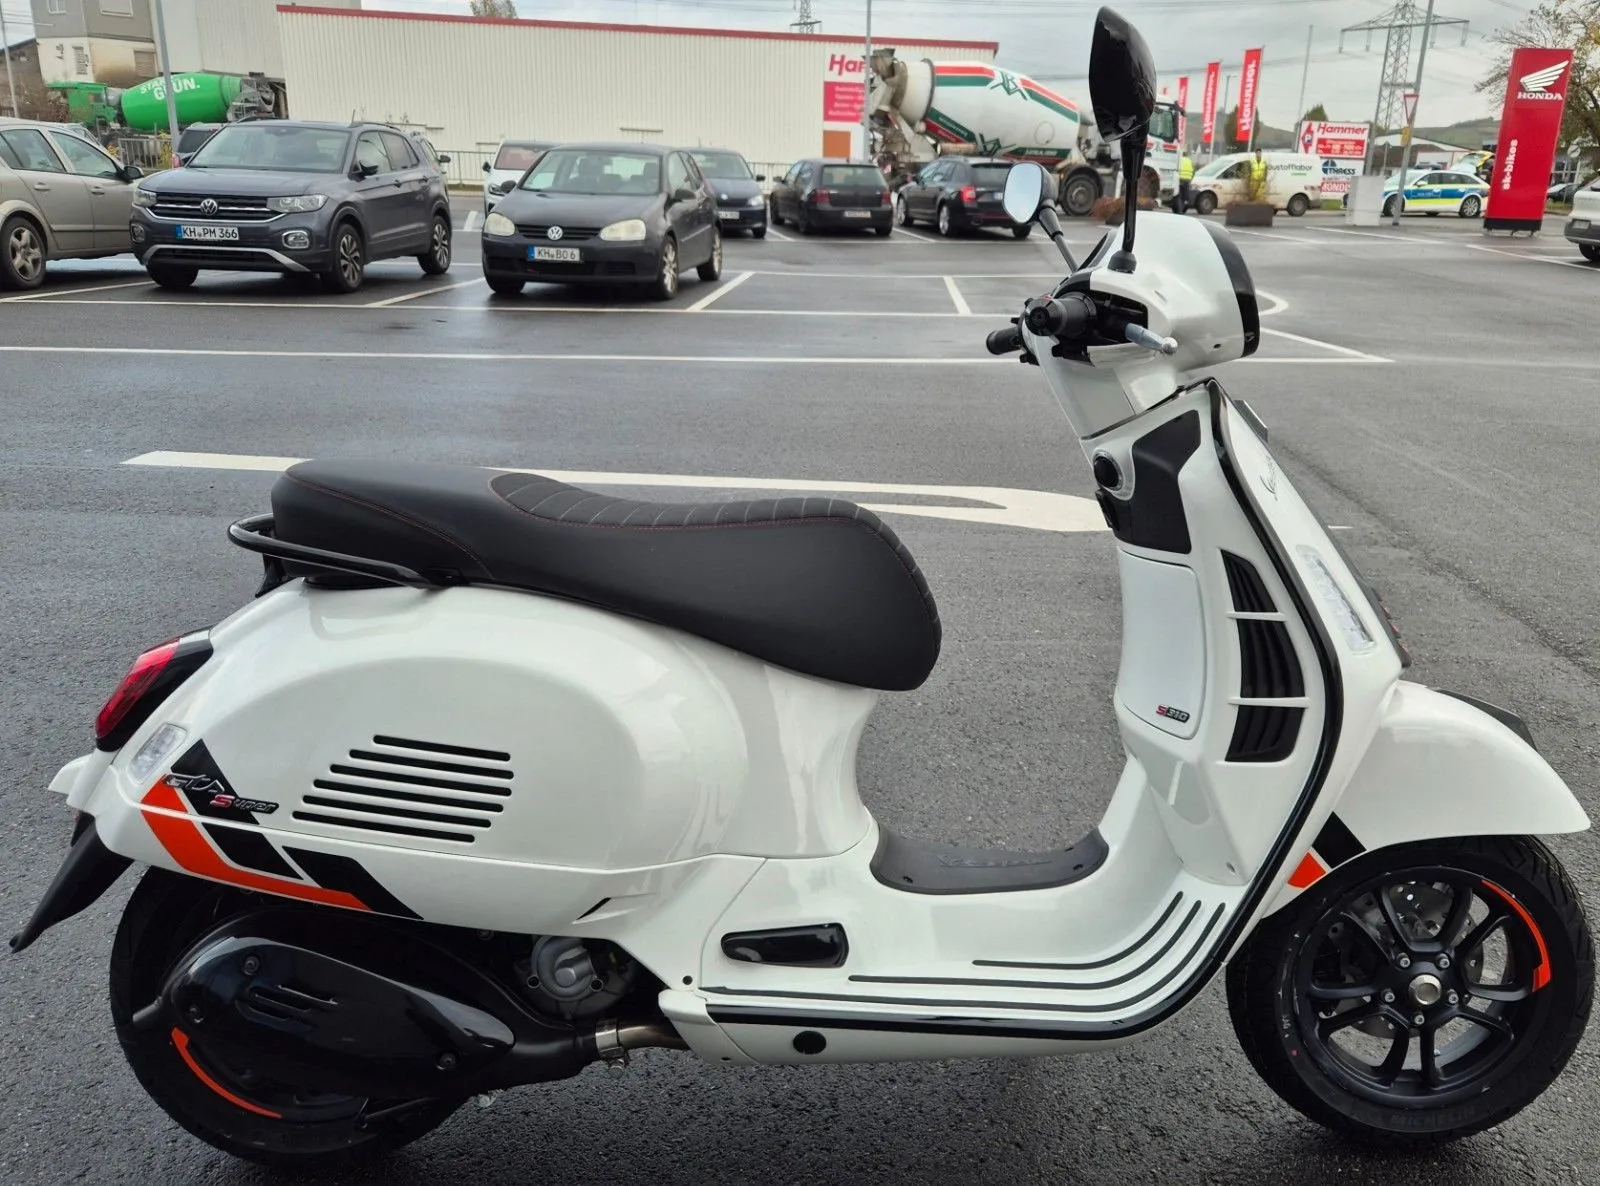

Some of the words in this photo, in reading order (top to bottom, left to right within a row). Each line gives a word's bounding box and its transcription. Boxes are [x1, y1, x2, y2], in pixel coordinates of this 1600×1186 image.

[1517, 91, 1563, 100] HONDA
[1317, 122, 1367, 135] Hammer
[1502, 139, 1518, 190] sk-bikes
[219, 228, 238, 239] 366
